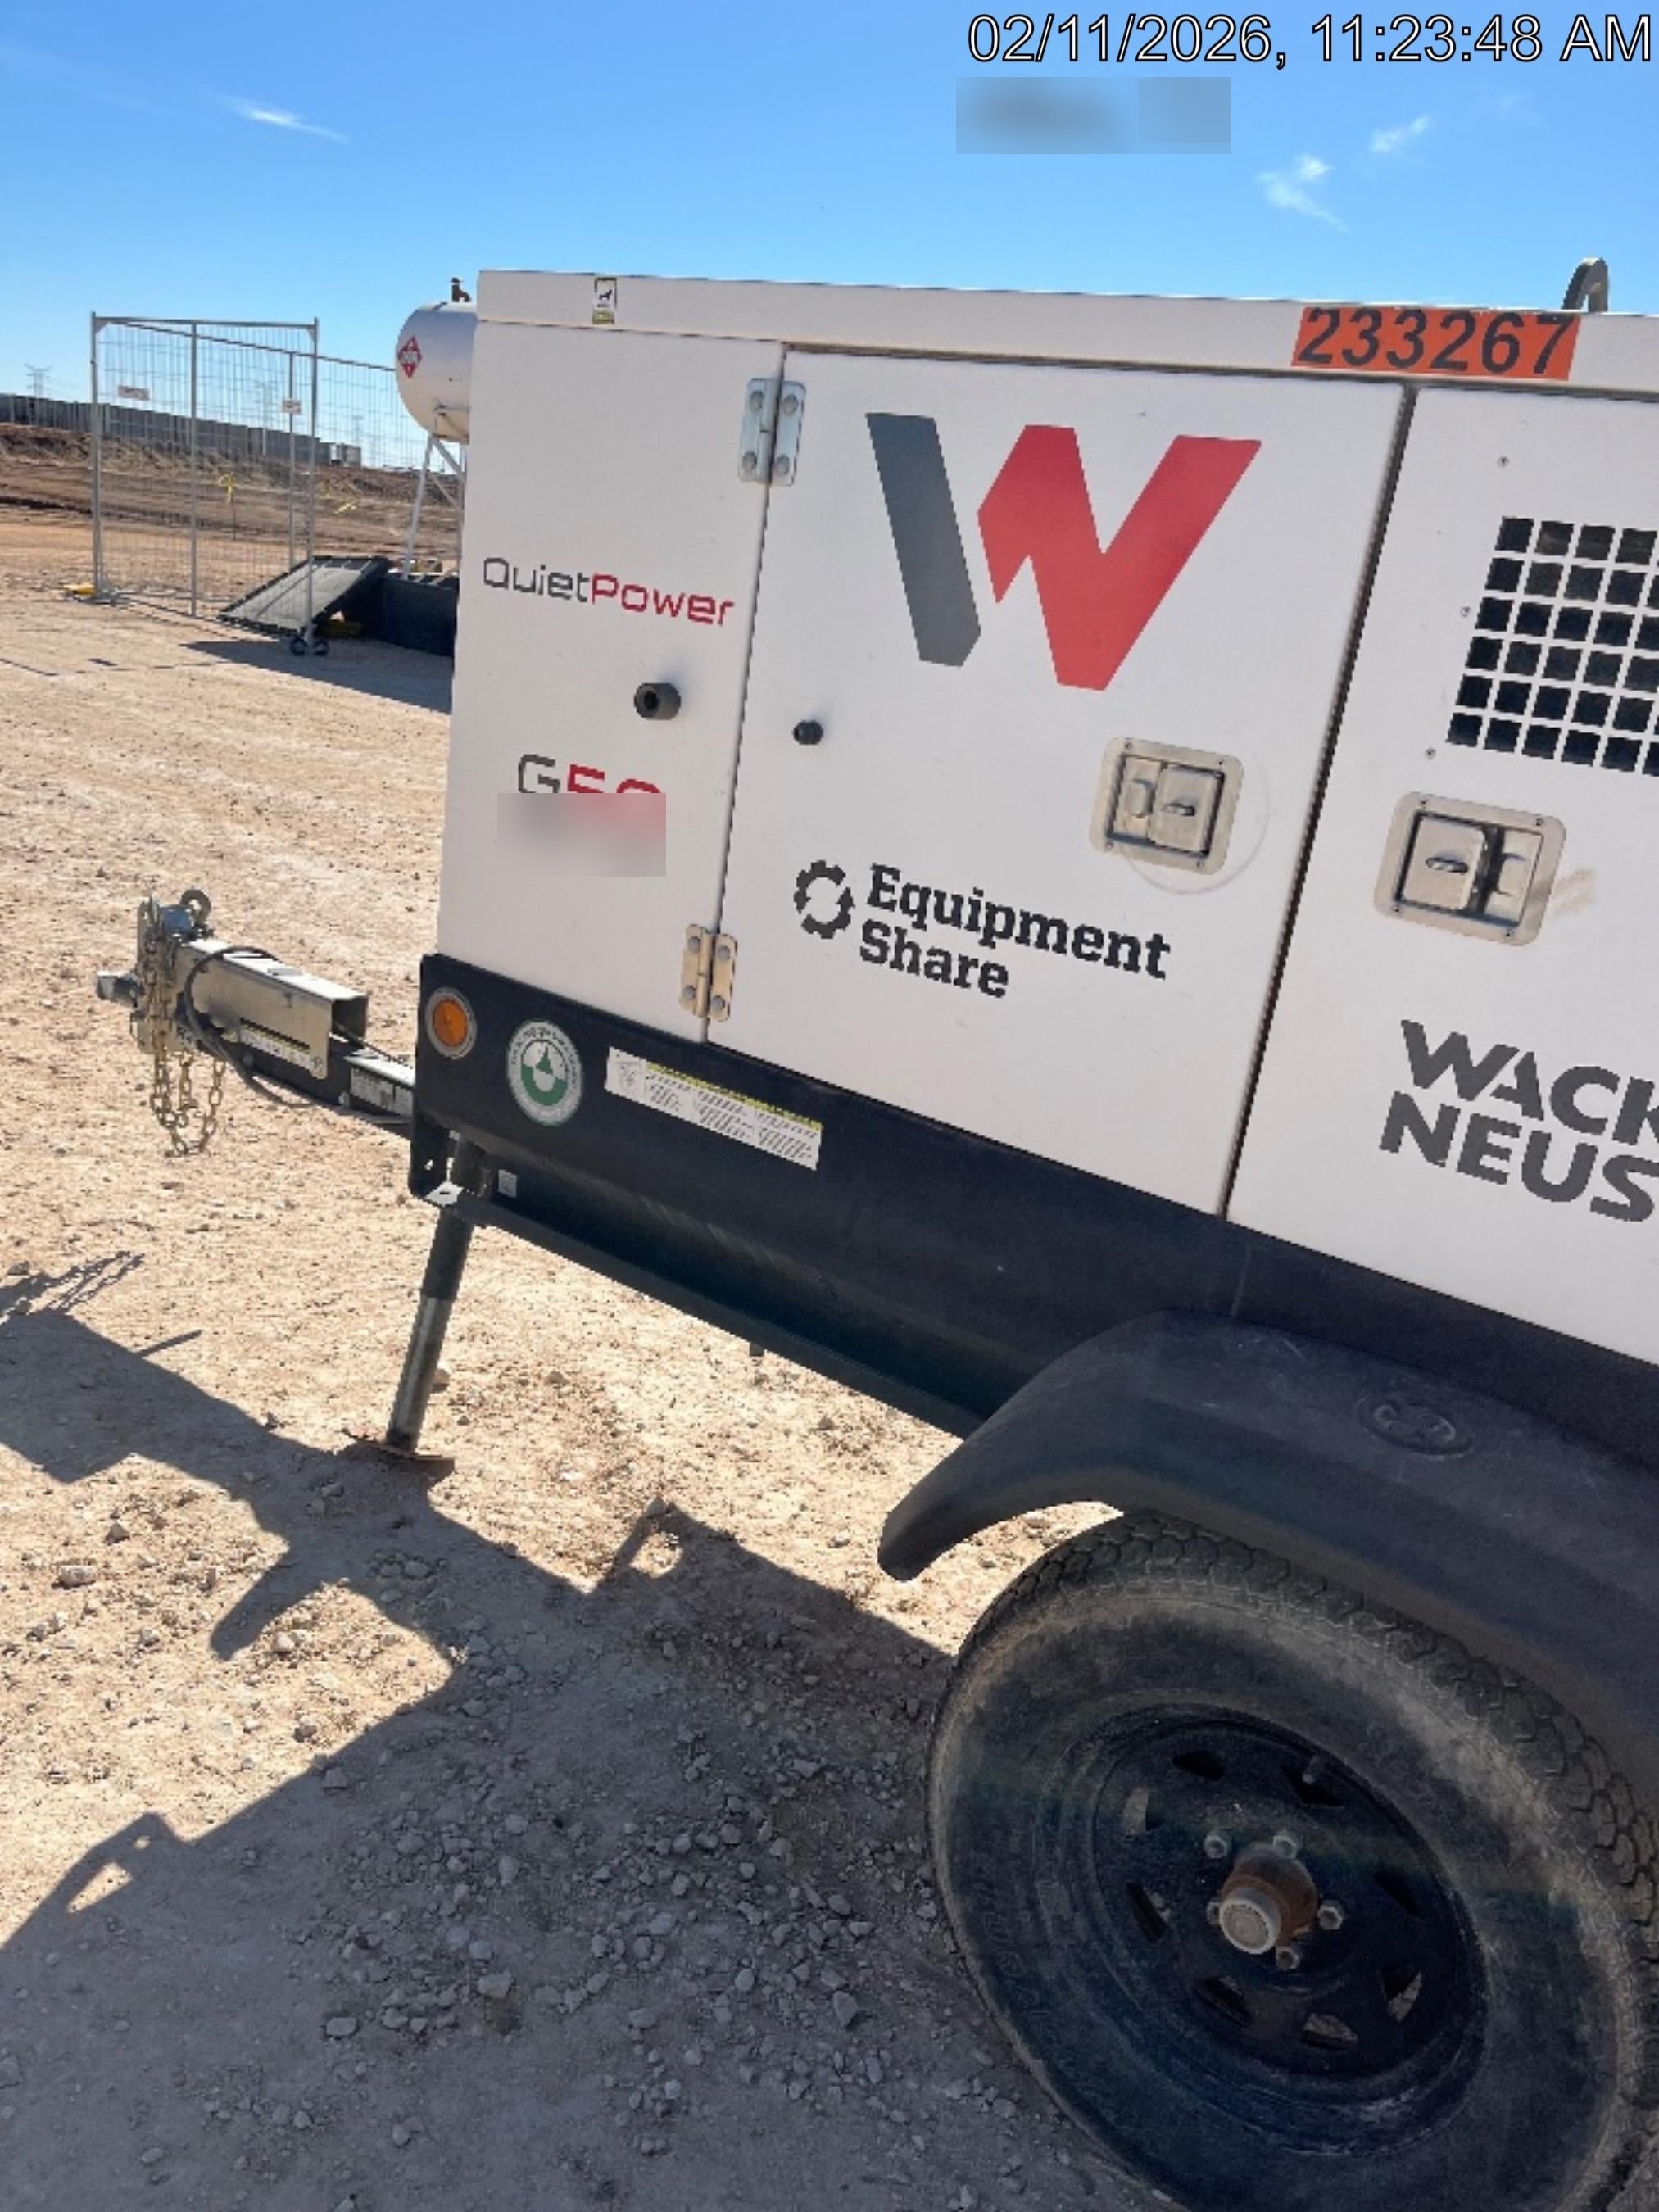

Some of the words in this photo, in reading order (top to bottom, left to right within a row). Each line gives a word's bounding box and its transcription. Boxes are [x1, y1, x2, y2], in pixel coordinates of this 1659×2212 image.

[1298, 307, 1575, 374] 233267
[483, 557, 735, 626] QuietPower
[859, 918, 1009, 999] Share
[866, 863, 1171, 981] Equipment
[1379, 1090, 1659, 1222] NEUS
